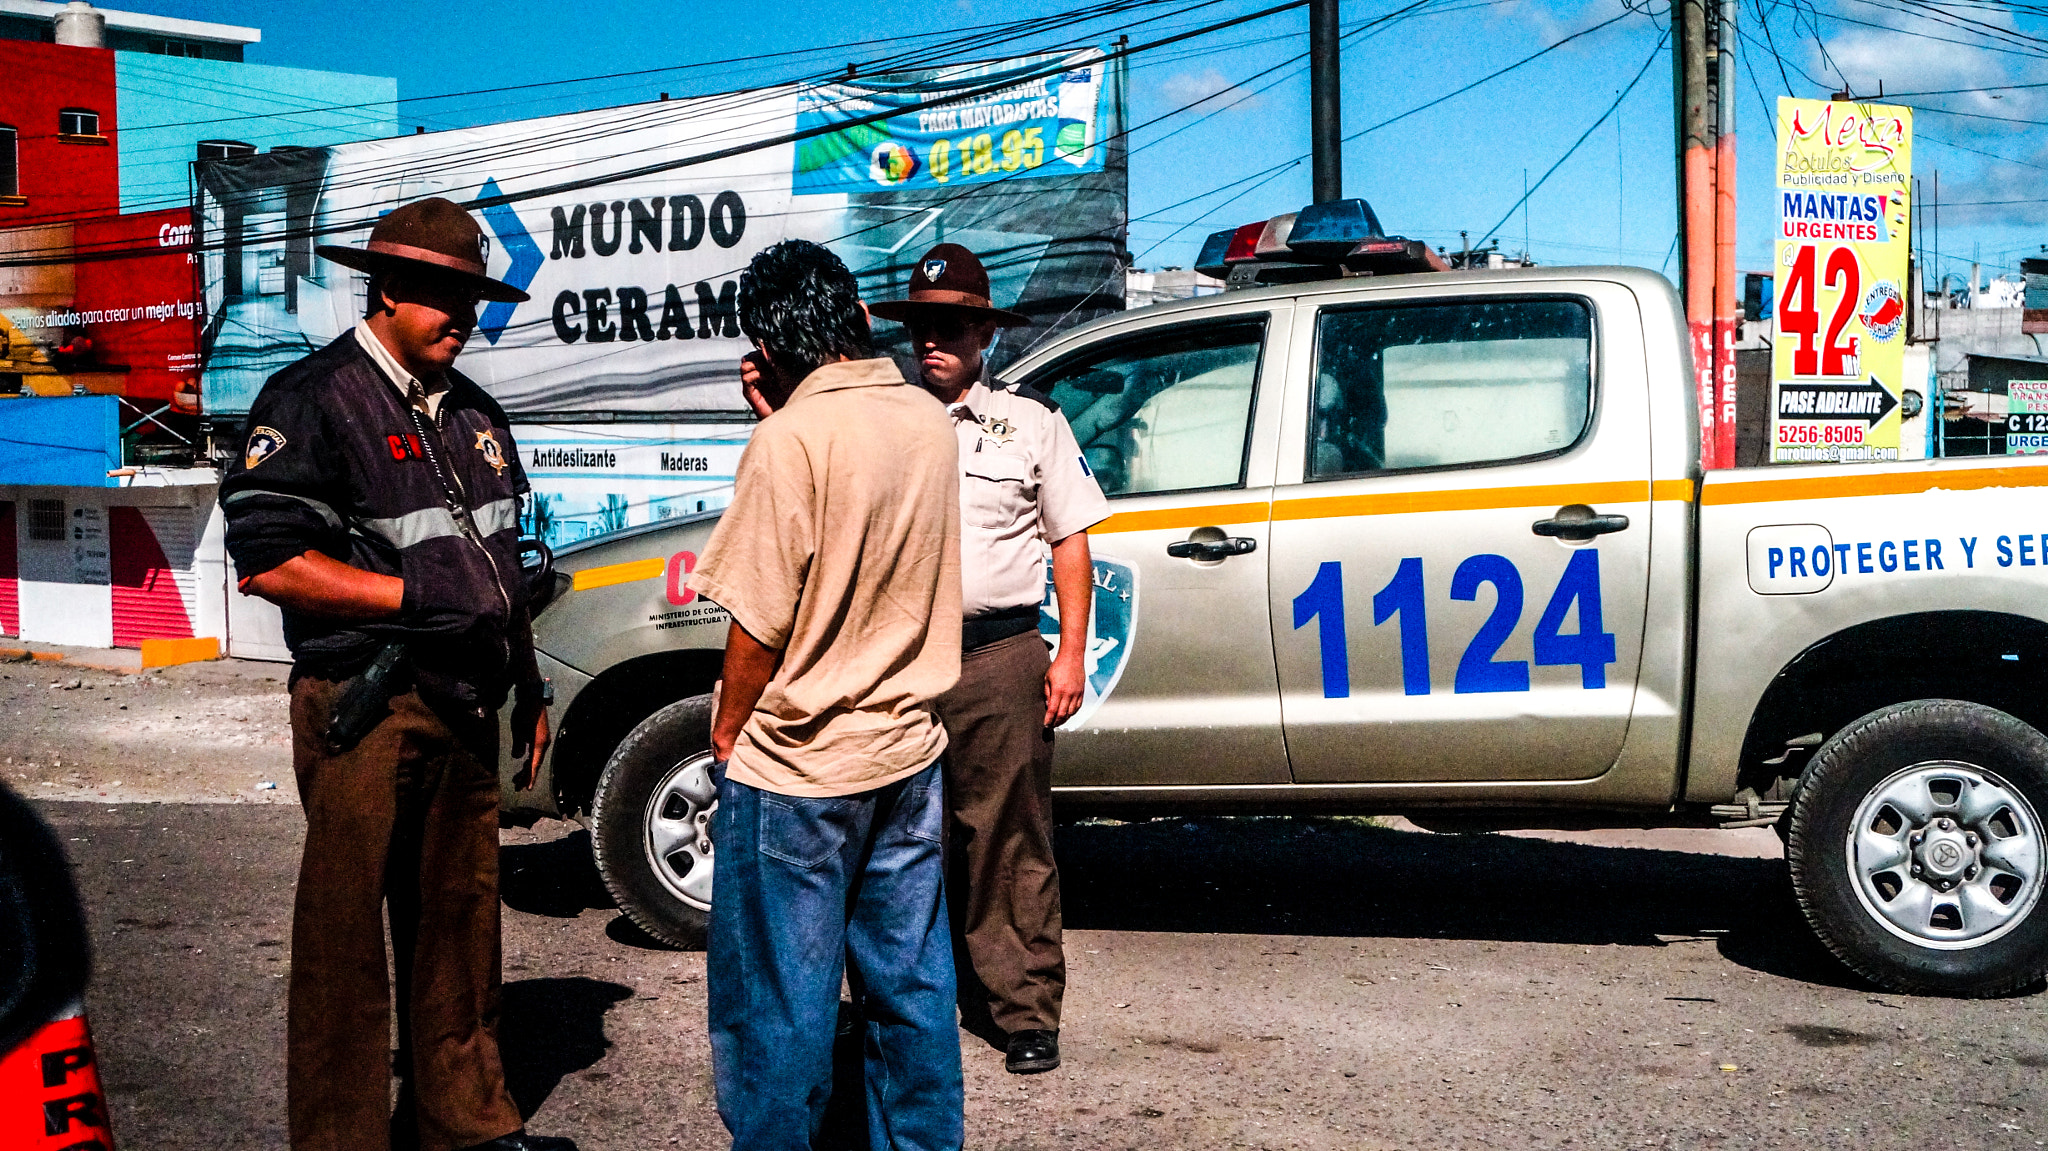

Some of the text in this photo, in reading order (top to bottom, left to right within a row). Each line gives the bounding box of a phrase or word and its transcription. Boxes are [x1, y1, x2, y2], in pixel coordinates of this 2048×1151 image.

[919, 110, 959, 133] PARA
[960, 96, 1059, 130] MAYORISTAS
[957, 127, 1044, 175] 18.95
[1783, 172, 1905, 187] Publicidad y Diseño
[1783, 192, 1878, 222] MANTAS
[159, 223, 196, 247] Com
[550, 190, 747, 260] MUNDO
[1784, 221, 1877, 241] URGENTES
[45, 309, 81, 328] aliados
[81, 309, 104, 328] para
[104, 308, 130, 323] crear
[131, 306, 144, 320] un
[145, 300, 175, 323] mejor
[552, 279, 741, 344] CERAM
[1779, 245, 1860, 376] 42
[1780, 391, 1883, 414] PASE ADELANTE
[1779, 425, 1864, 443] 5256-8505
[2008, 415, 2021, 432] C
[532, 448, 708, 472] Antideslizante Maderas
[1767, 540, 1945, 580] PROTEGER
[1959, 536, 1979, 569] Y
[648, 609, 691, 622] MINISTERIO
[692, 608, 702, 616] DE
[655, 615, 722, 631] INFRAESTRUCTURA
[1292, 548, 1617, 699] 1124
